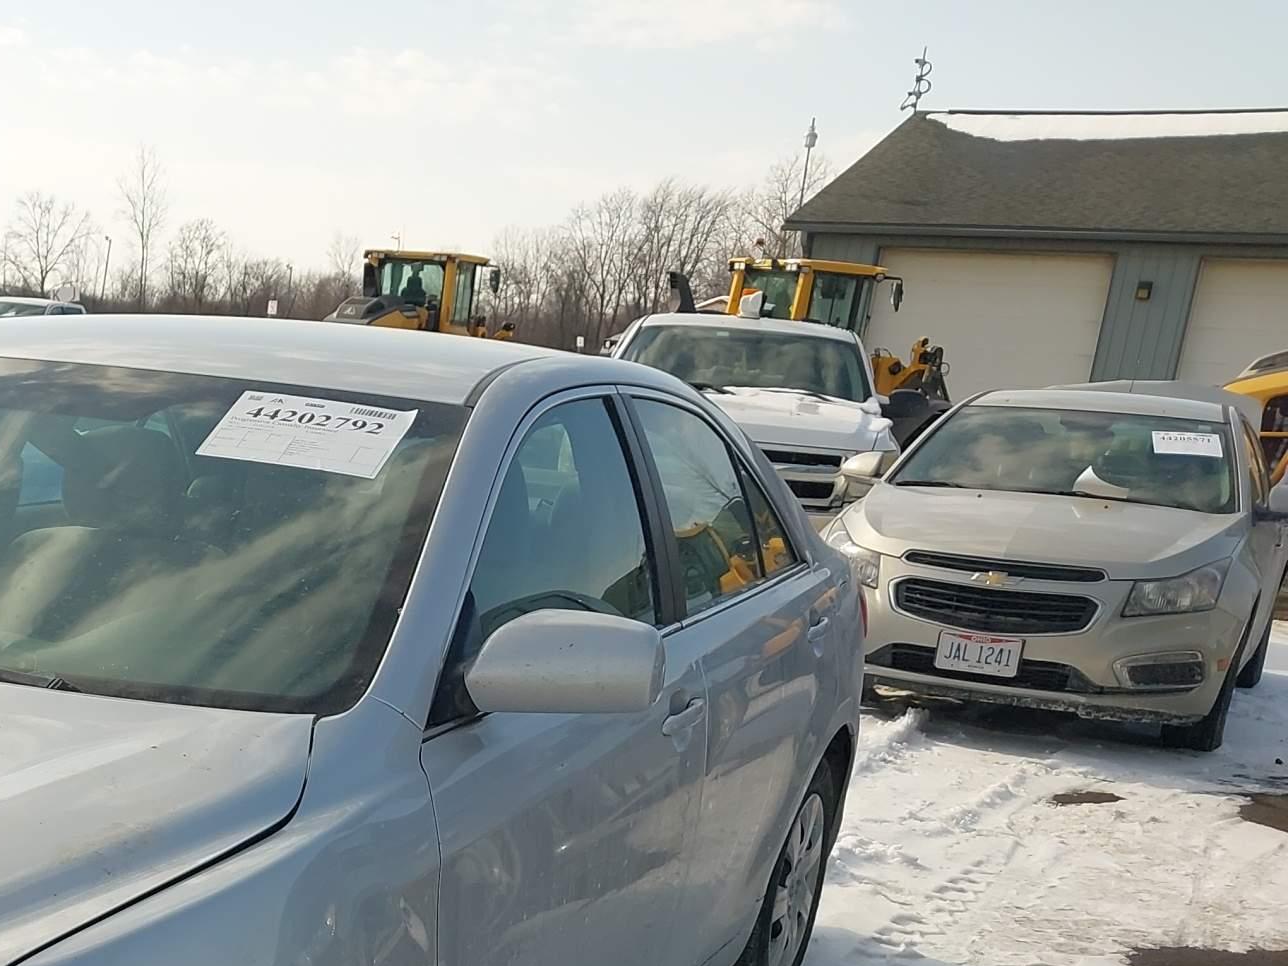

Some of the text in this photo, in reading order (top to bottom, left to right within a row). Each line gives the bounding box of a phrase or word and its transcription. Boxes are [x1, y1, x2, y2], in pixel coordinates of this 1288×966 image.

[246, 406, 385, 435] 44202792
[944, 642, 1012, 668] JAL 1241
